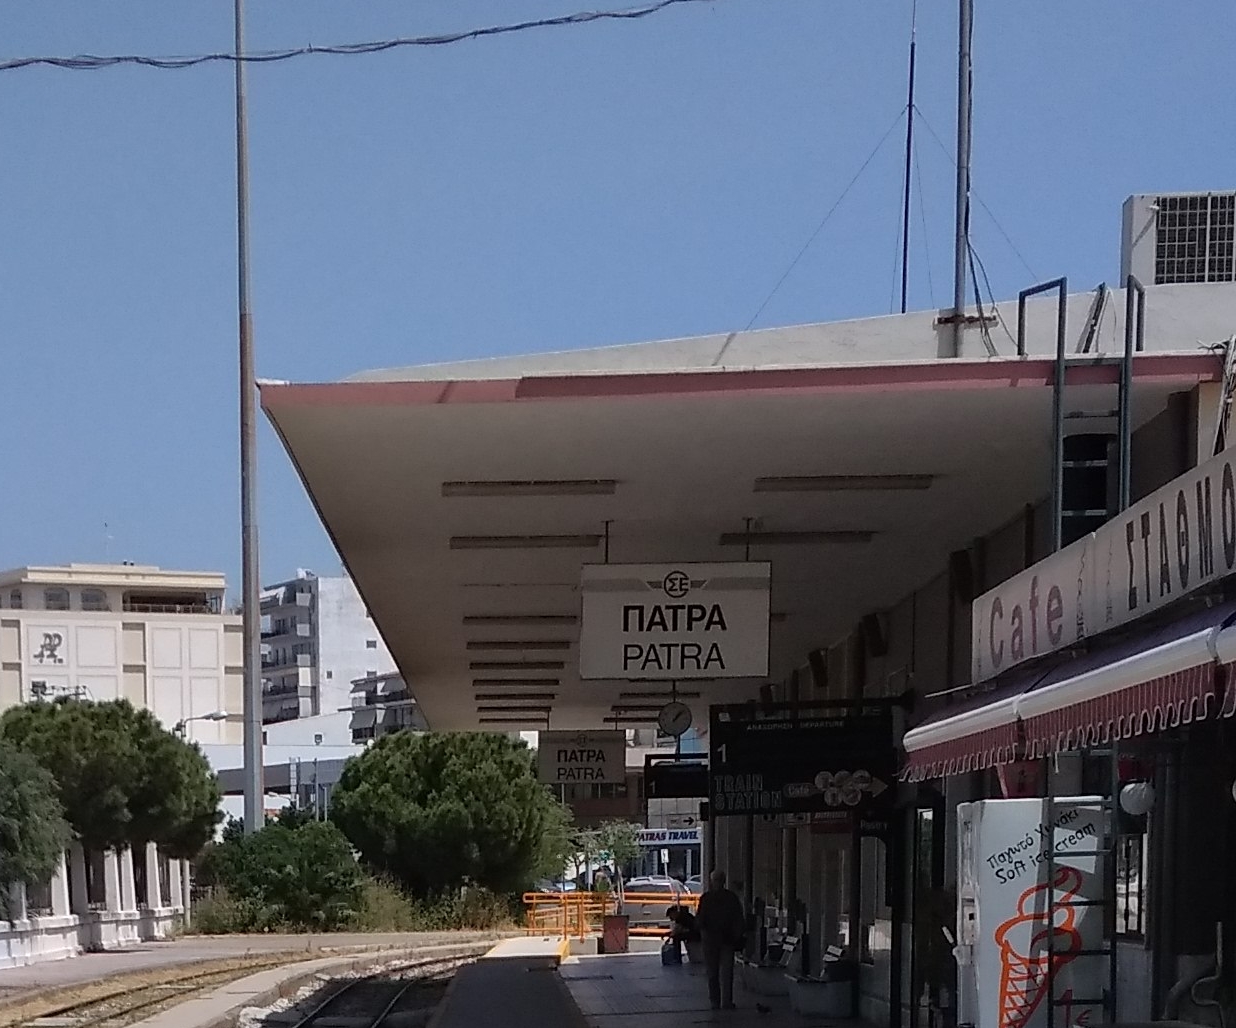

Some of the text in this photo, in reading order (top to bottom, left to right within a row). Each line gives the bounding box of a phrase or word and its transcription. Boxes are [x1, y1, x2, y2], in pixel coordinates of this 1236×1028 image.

[622, 604, 727, 632] ΠΑΤΡΑ
[990, 575, 1063, 668] Cafe
[622, 642, 726, 671] PATRA
[557, 749, 606, 763] ΠΑΤΡΑ
[717, 743, 727, 763] 1
[557, 767, 605, 780] PATRA
[714, 773, 763, 793] TRAIN
[714, 790, 782, 811] STATION
[668, 831, 699, 841] TRAVEL
[995, 822, 1096, 885] Soft ice cream
